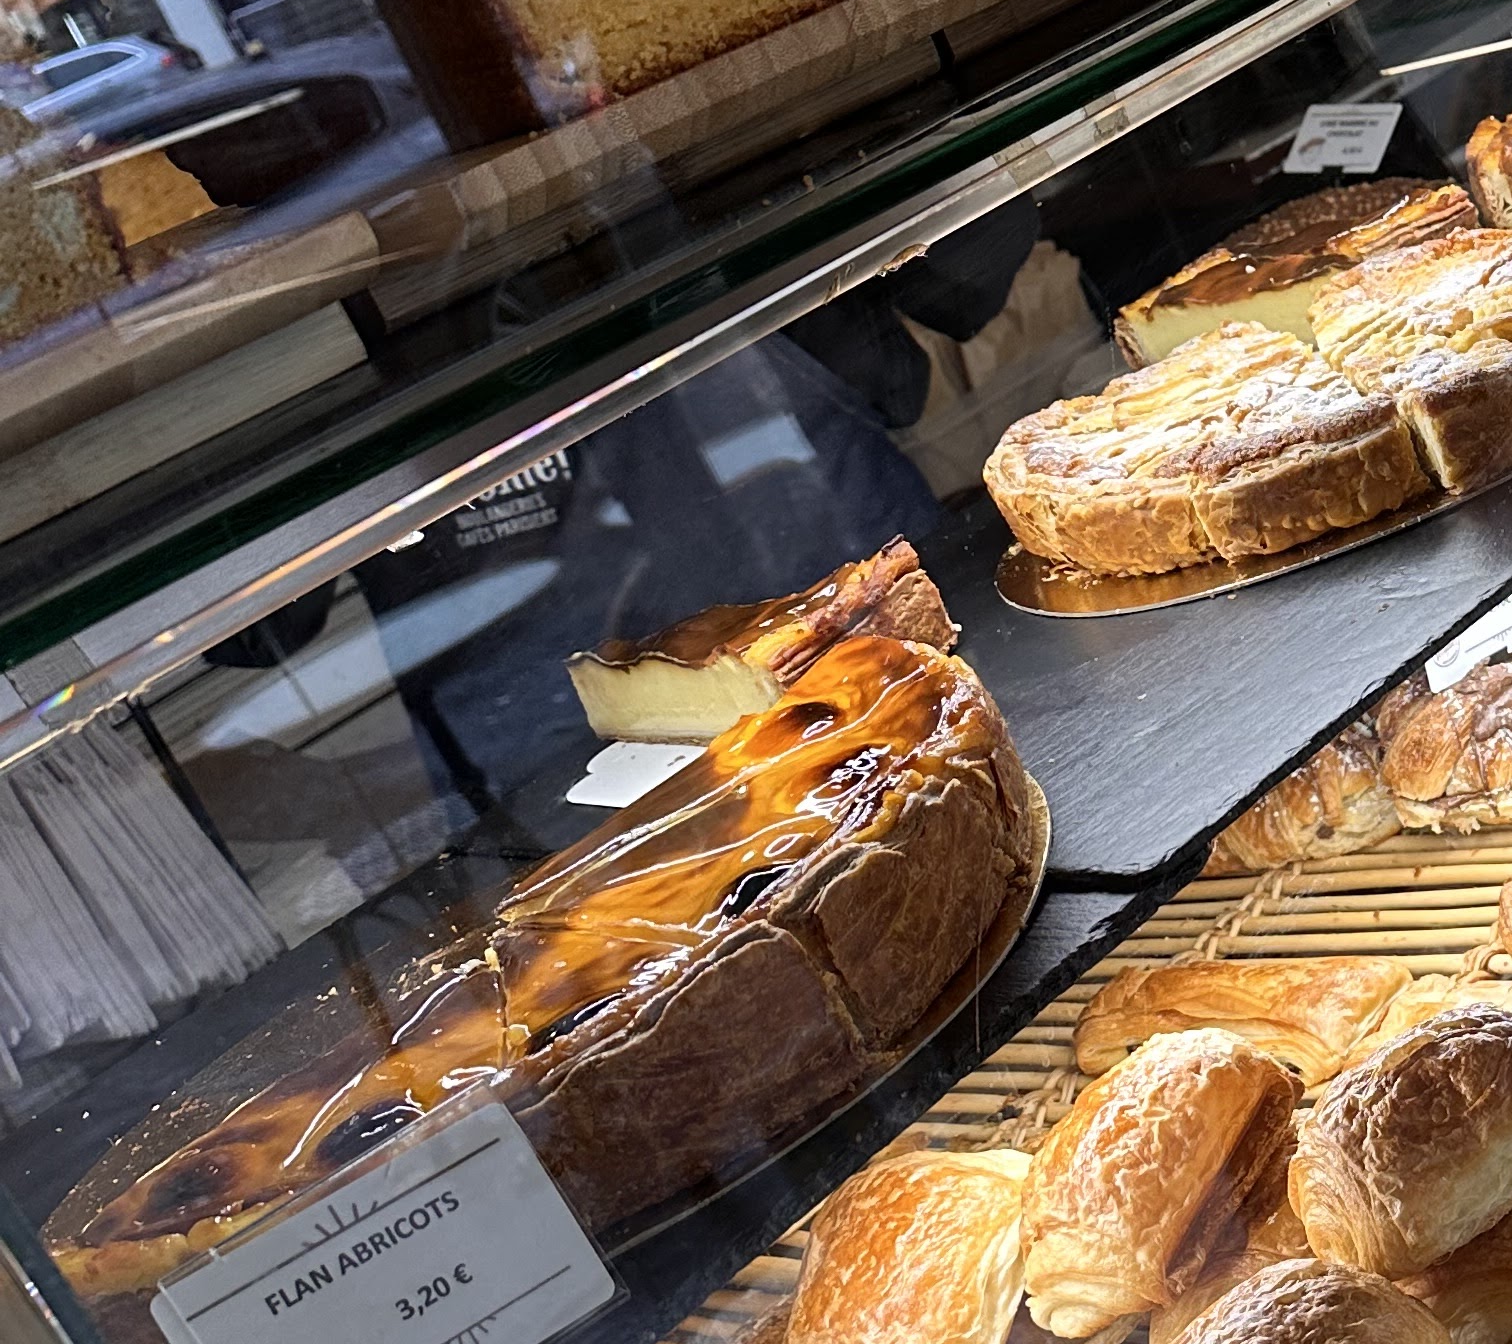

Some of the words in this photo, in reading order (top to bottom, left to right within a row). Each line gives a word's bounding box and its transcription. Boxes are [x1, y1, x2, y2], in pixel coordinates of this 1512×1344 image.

[264, 1262, 334, 1316] FLAN
[338, 1189, 461, 1276] ABRICOTS
[395, 1274, 453, 1321] 3,20
[453, 1262, 475, 1285] €
